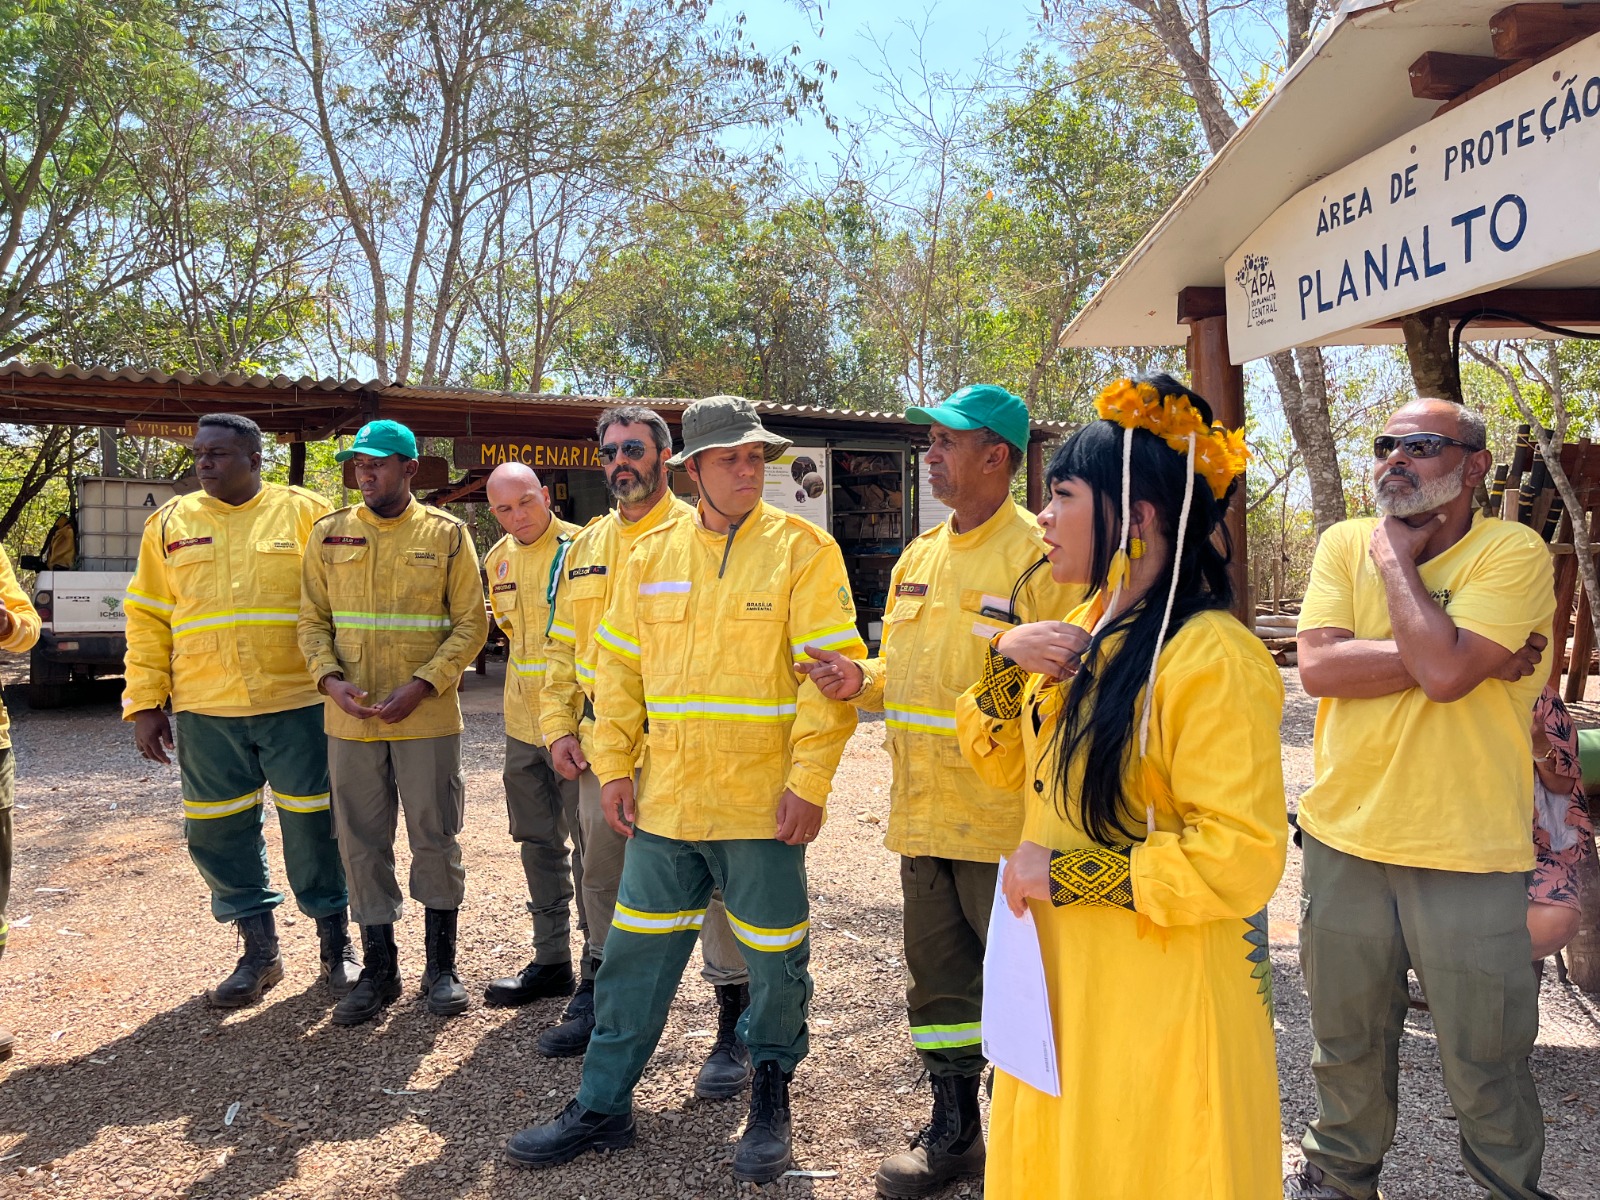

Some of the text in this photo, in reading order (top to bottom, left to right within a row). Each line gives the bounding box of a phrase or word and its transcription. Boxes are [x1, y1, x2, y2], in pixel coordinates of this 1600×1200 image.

[1316, 74, 1600, 237] ÁREA DE PROTEÇÃO
[1298, 193, 1528, 321] PLANALTO
[1250, 269, 1276, 298] APA
[1251, 301, 1278, 319] CENTRAL
[137, 423, 194, 437] VTR-01
[481, 443, 602, 467] MARCENARIA
[143, 492, 157, 507] A
